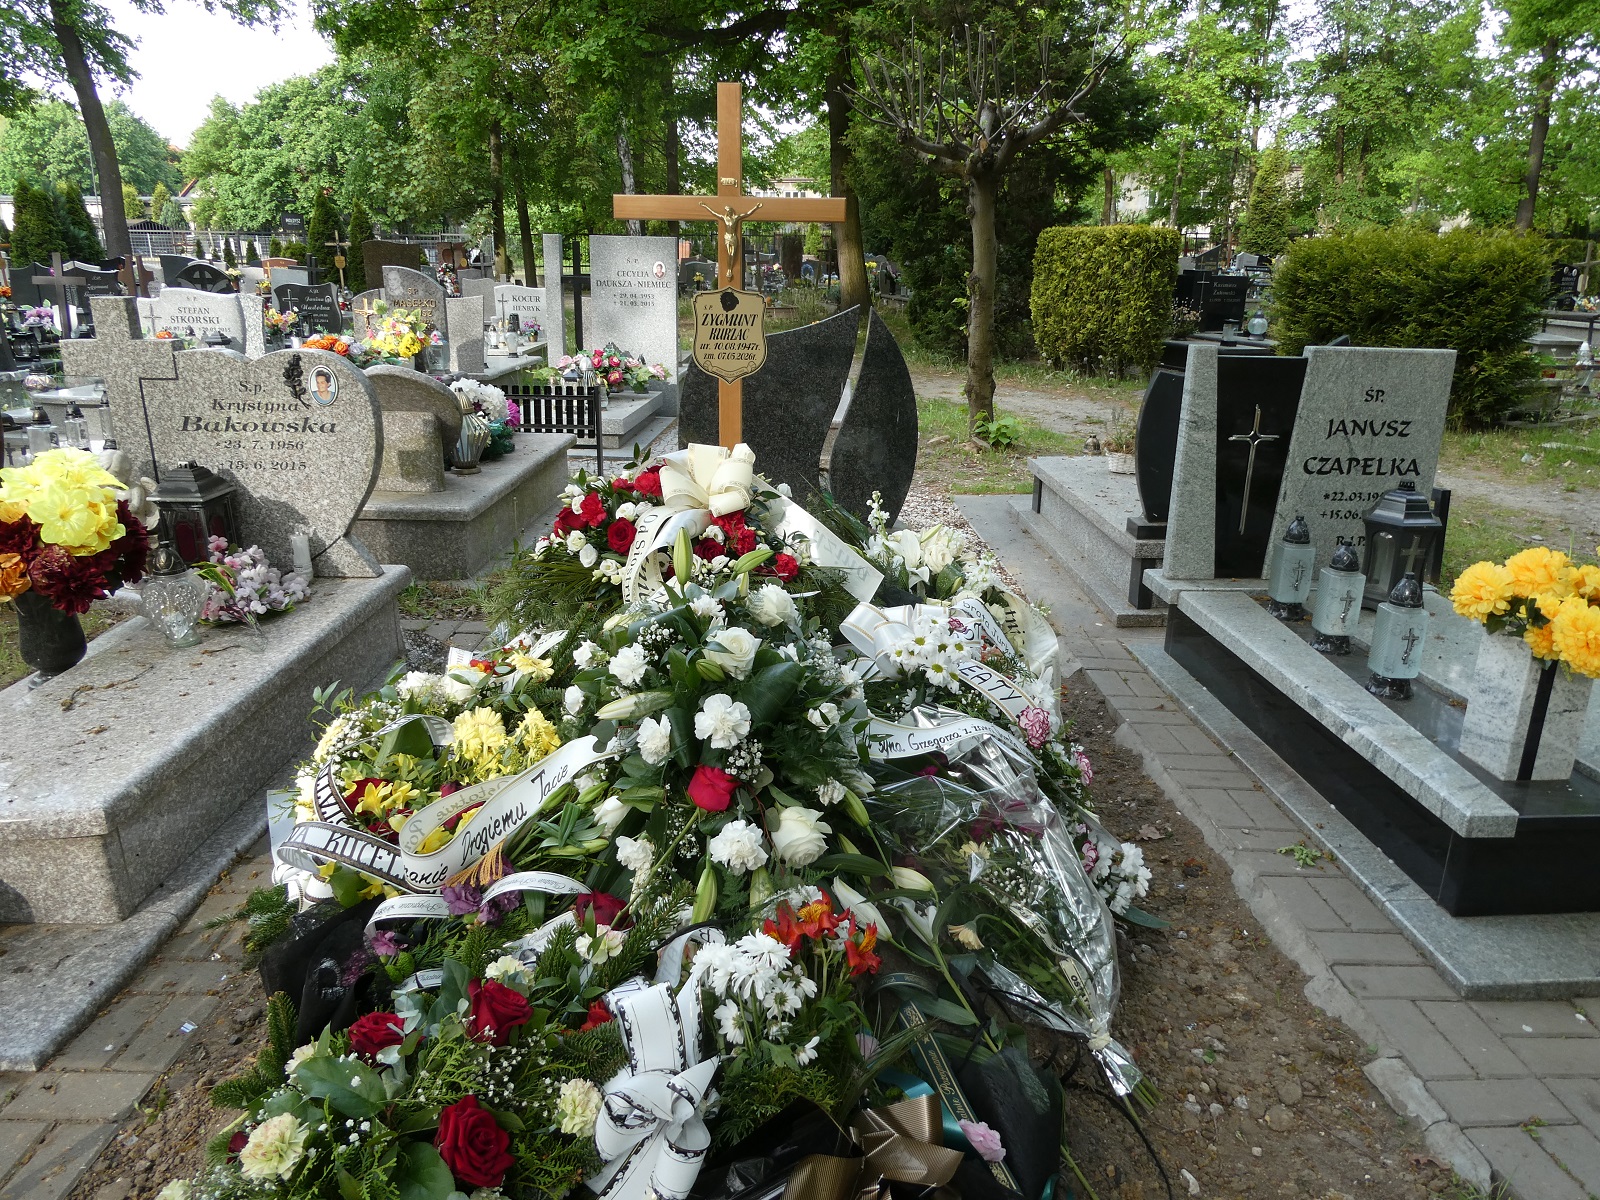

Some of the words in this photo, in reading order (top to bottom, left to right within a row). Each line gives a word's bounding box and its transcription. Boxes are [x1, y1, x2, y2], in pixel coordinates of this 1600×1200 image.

[616, 270, 650, 278] CECYLIA
[596, 280, 633, 288] DAUKSZA
[637, 280, 672, 289] NIEMIEC
[511, 295, 541, 303] KOCUR
[177, 306, 210, 315] STEFAN
[170, 315, 221, 325] SIKORSKI
[701, 313, 759, 327] ZYGMUNT
[708, 327, 750, 341] KURZAC
[699, 342, 711, 350] ur.
[211, 398, 299, 414] Krystyna
[178, 415, 337, 434] Bakowska
[1325, 418, 1413, 440] JANUSZ
[269, 439, 305, 451] 1956
[270, 460, 308, 472] 2015
[1302, 456, 1421, 477] CZAPELKA
[637, 514, 659, 534] Od
[957, 663, 1023, 701] EATY
[907, 731, 962, 751] Grzegorza
[530, 763, 570, 805] Tacie
[460, 801, 528, 867] Drogiemu
